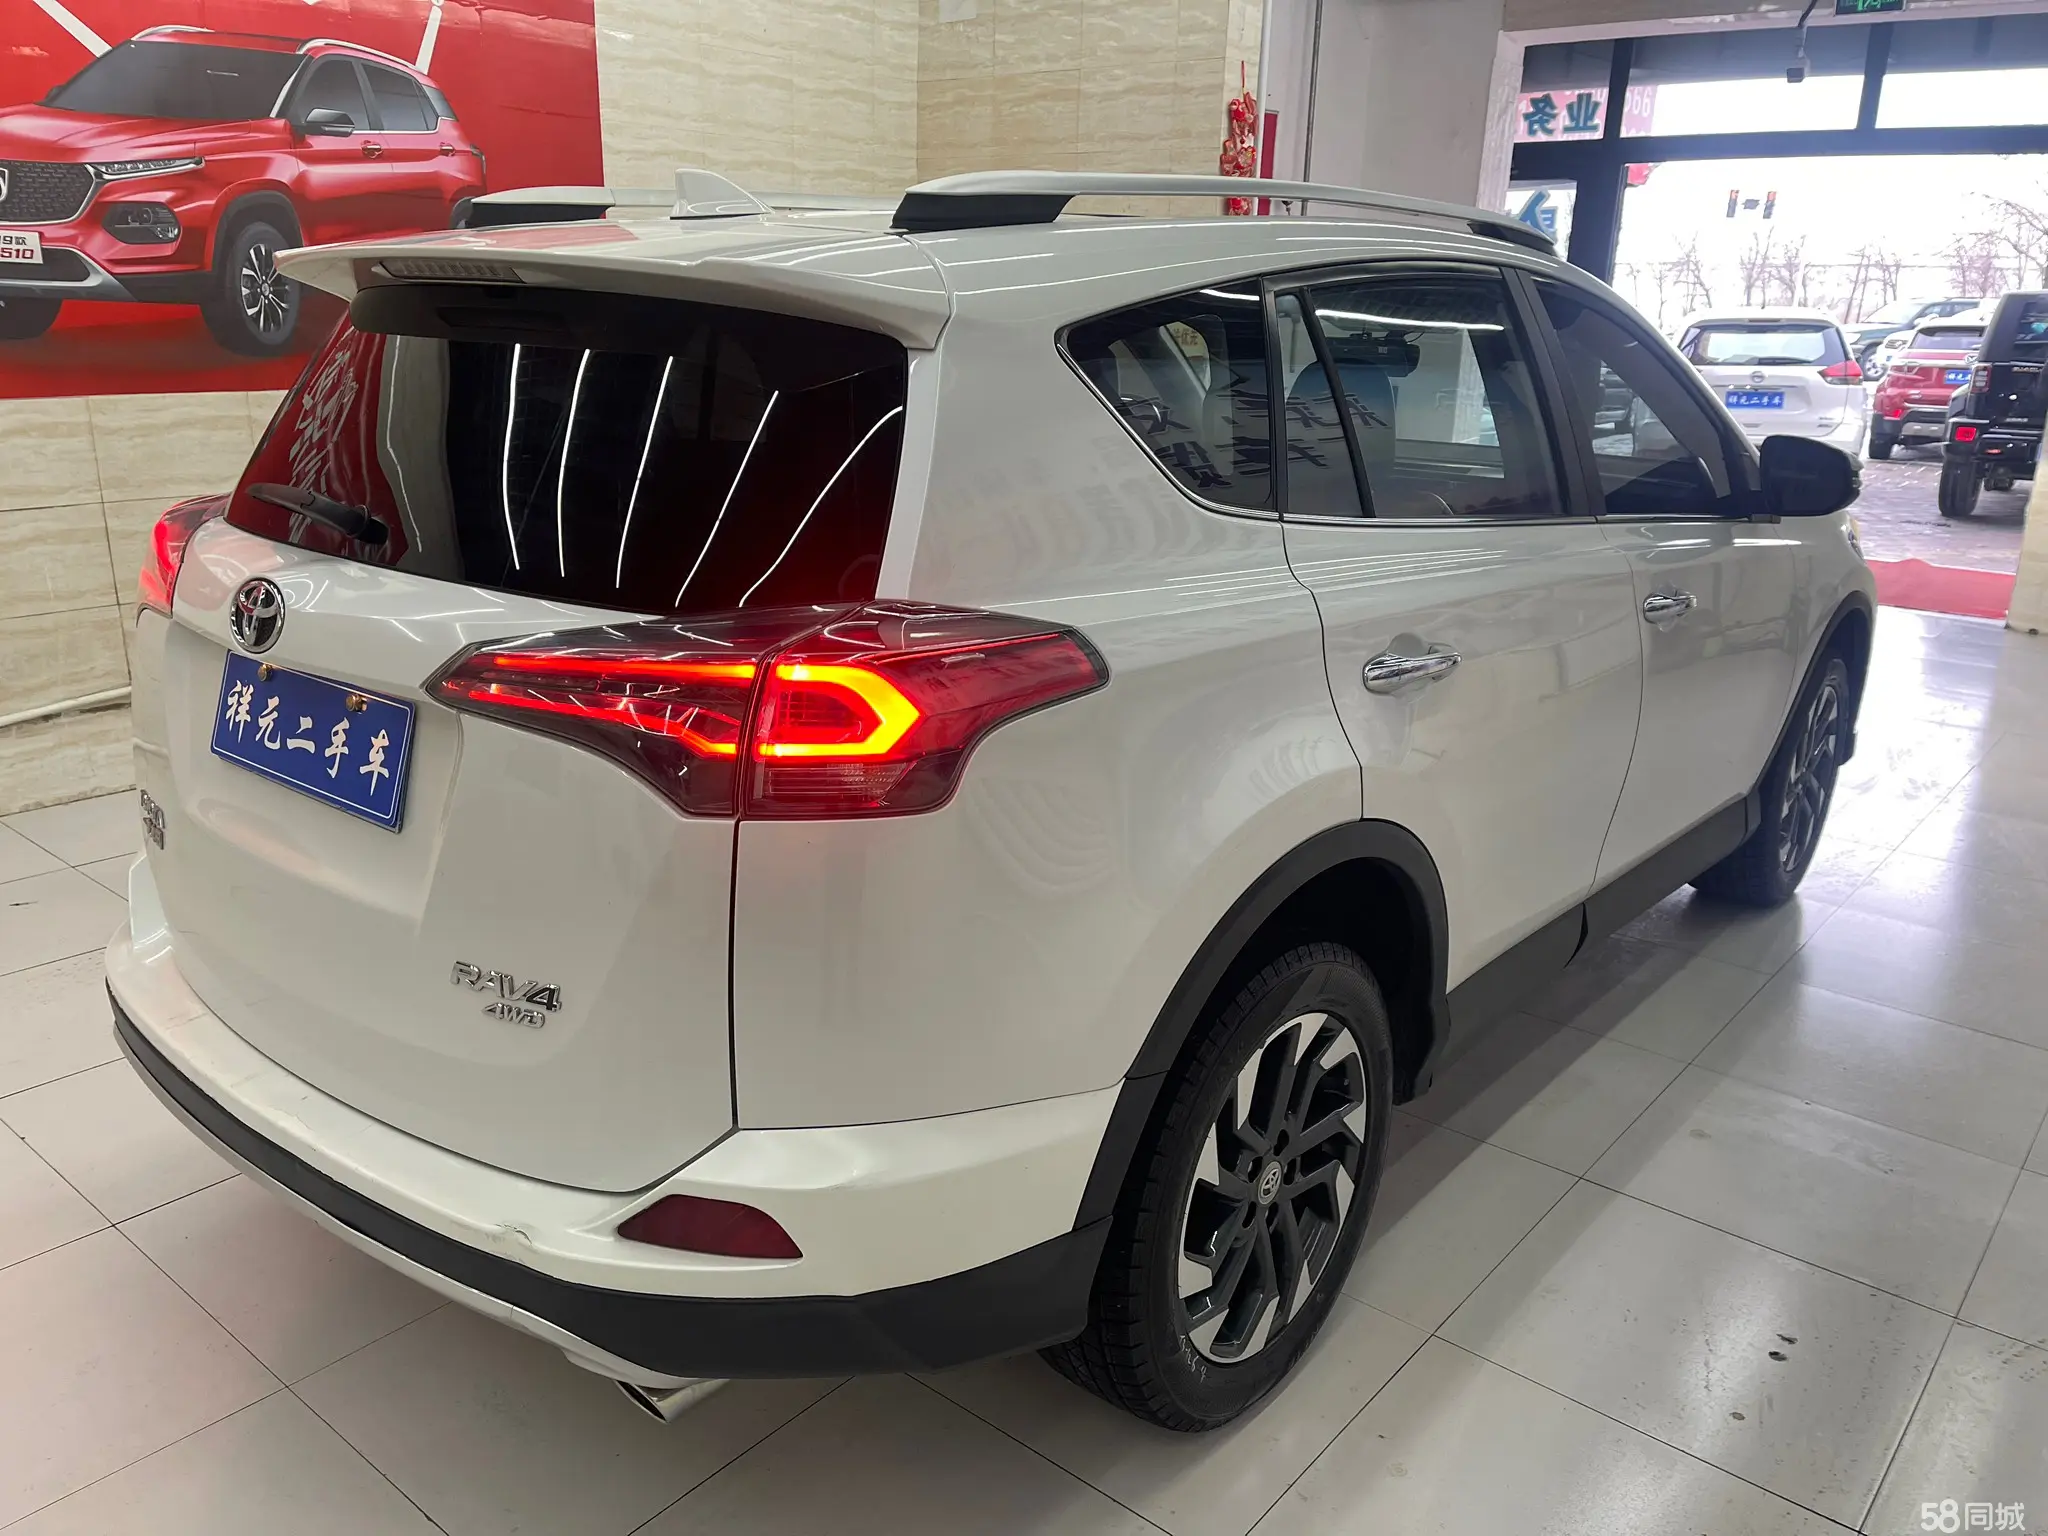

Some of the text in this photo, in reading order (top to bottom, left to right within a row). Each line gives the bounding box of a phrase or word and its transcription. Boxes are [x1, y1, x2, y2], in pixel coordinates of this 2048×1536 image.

[225, 679, 390, 796] 祥元二手车
[450, 960, 562, 1012] RAV4
[481, 1002, 546, 1029] 4WD
